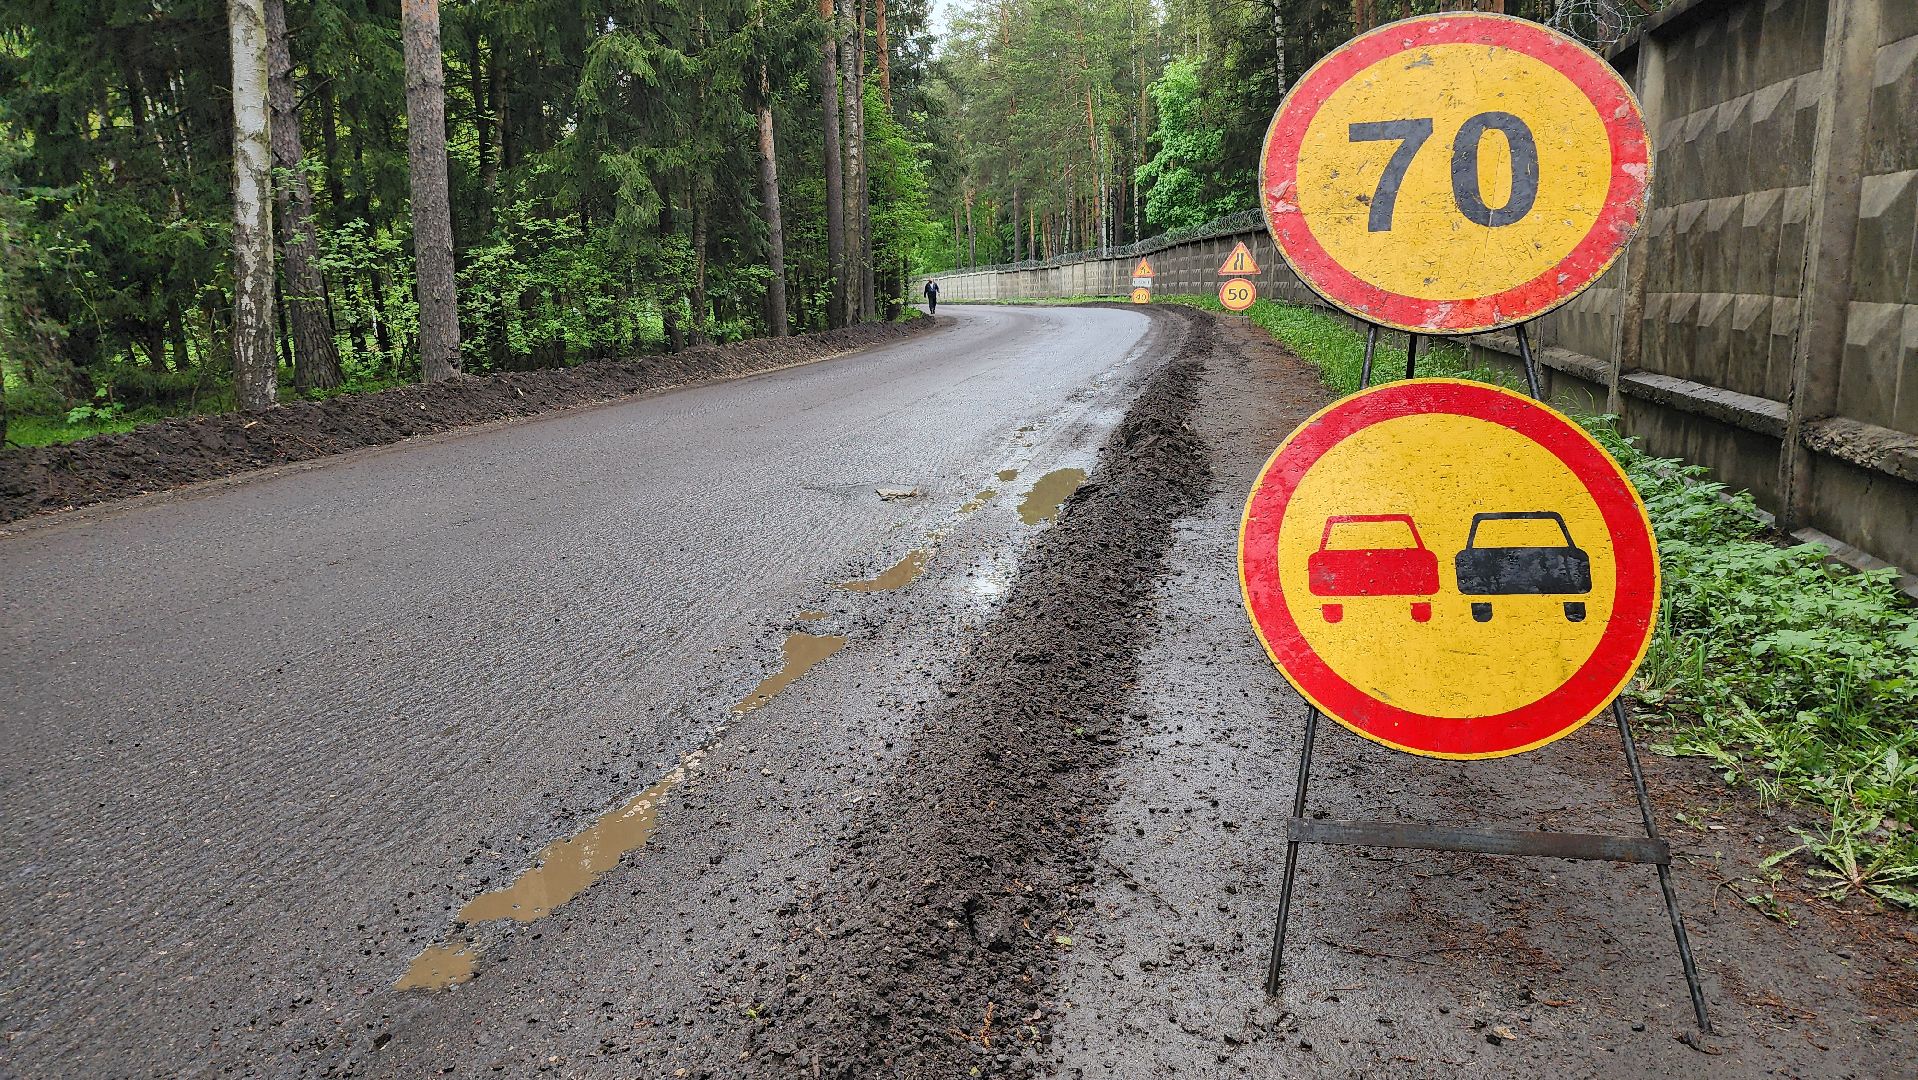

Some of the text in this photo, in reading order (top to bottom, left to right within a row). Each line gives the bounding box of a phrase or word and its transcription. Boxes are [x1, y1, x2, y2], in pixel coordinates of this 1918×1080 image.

[1348, 110, 1540, 232] 70
[1135, 293, 1147, 301] 40
[1227, 288, 1248, 301] 50
